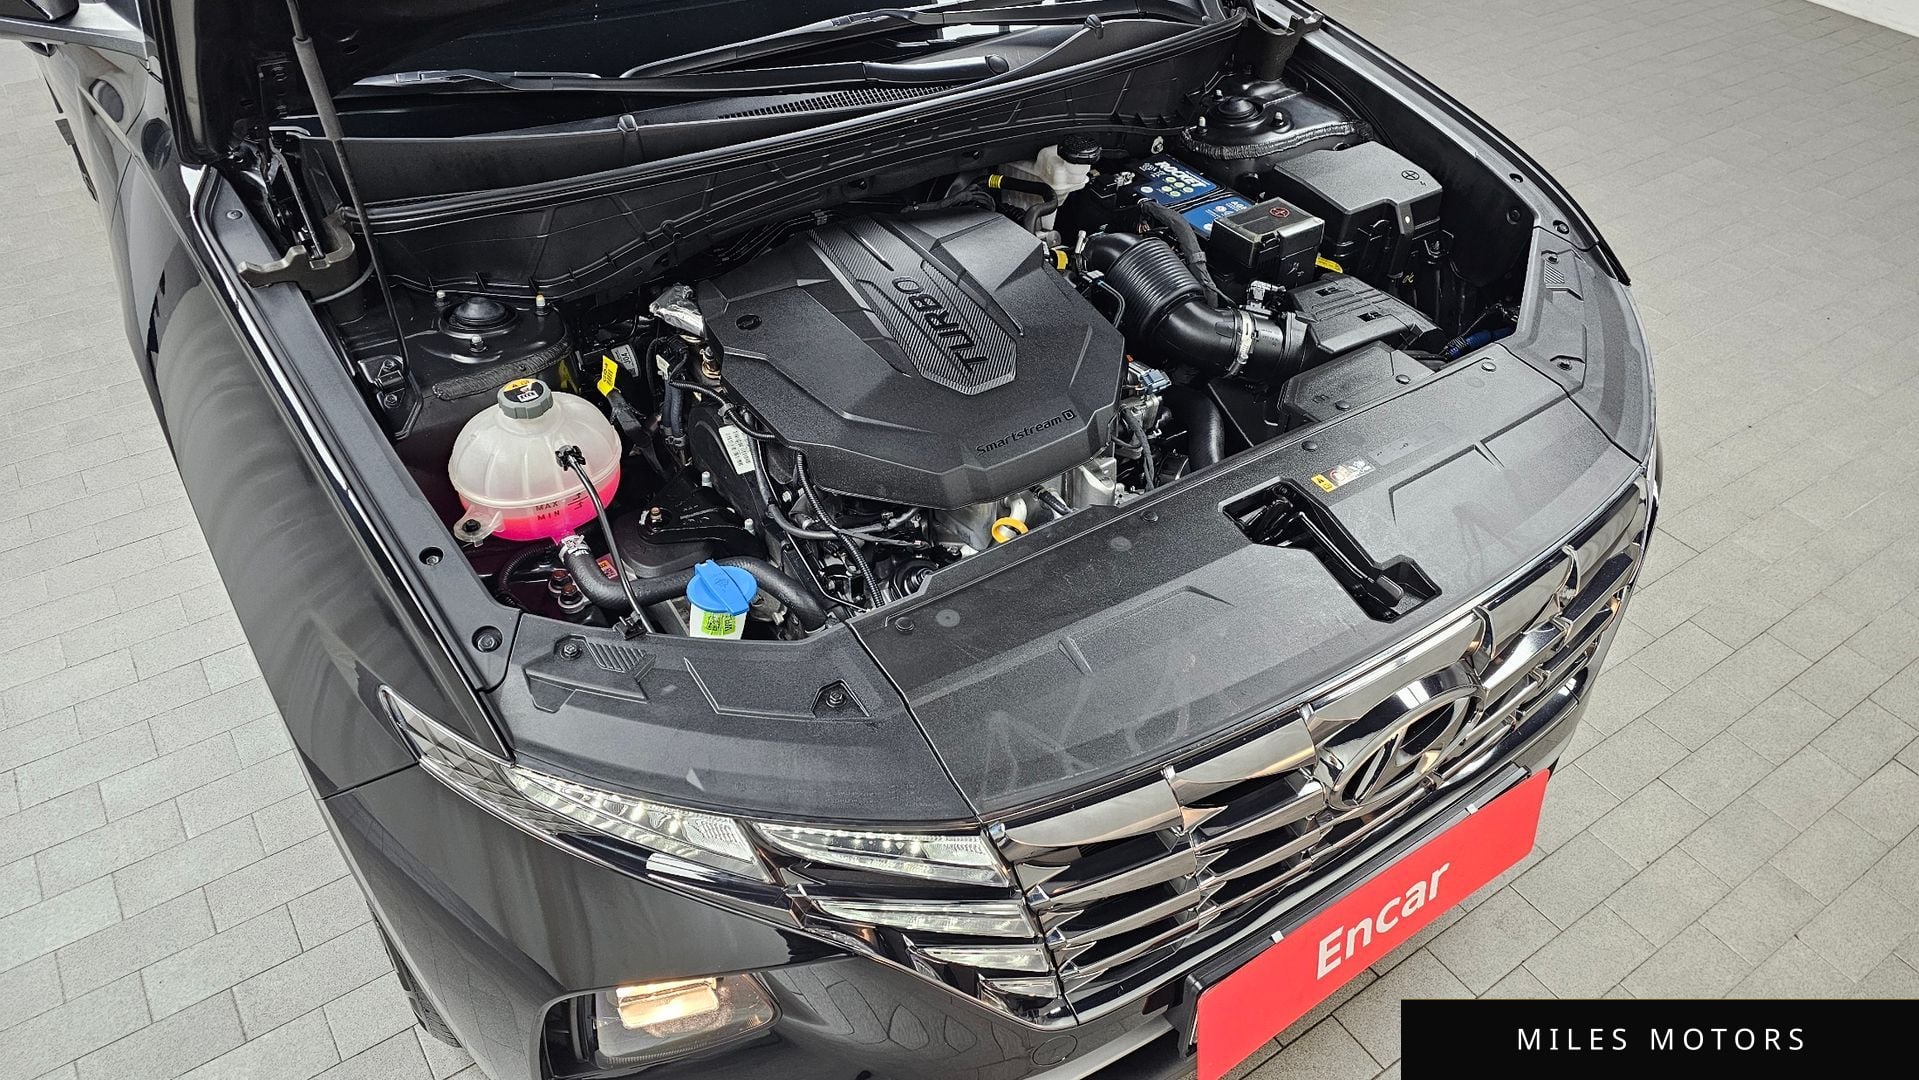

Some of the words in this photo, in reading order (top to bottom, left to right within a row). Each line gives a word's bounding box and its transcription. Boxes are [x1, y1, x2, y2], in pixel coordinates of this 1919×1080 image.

[1155, 161, 1207, 188] ROCKET
[892, 277, 989, 373] TURBO
[976, 416, 1062, 456] Smartstream
[535, 500, 559, 512] MAX
[537, 510, 560, 521] MIN
[1317, 862, 1450, 981] Encar
